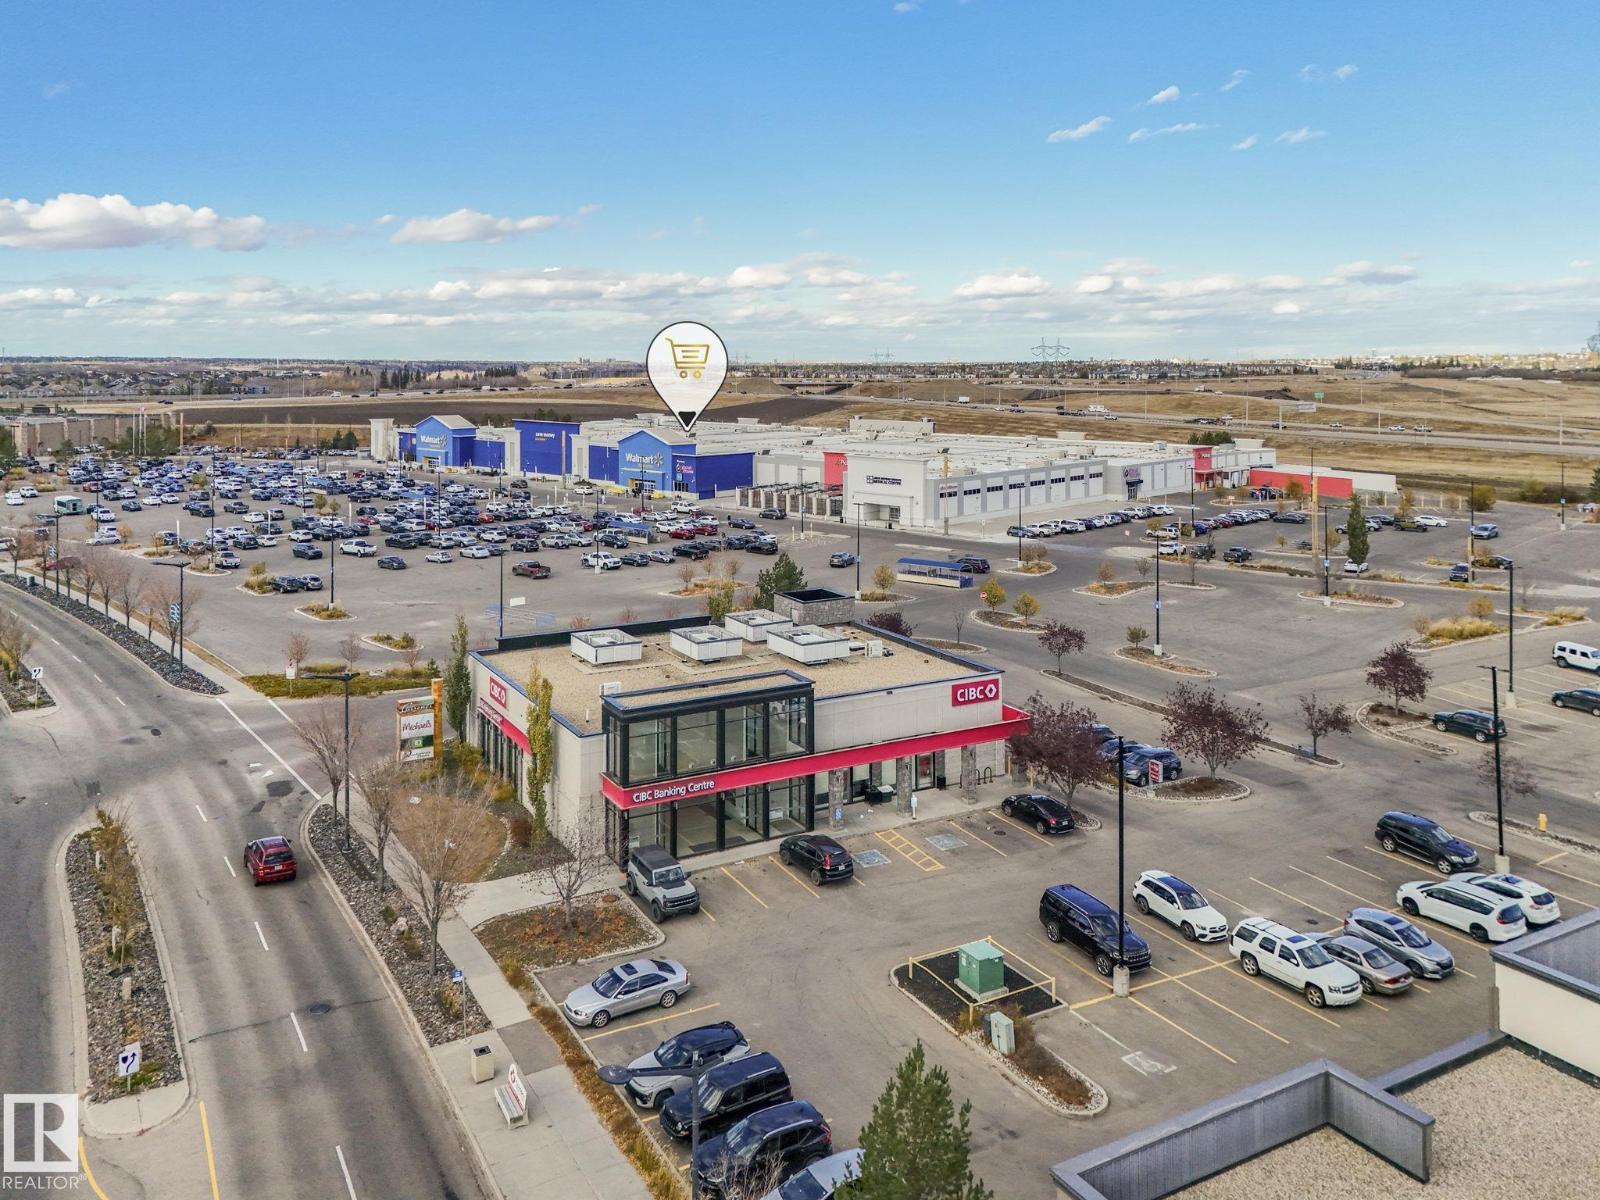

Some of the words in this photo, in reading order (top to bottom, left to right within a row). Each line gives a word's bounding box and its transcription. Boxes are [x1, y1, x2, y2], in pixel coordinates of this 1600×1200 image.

[420, 434, 441, 445] Walmart
[625, 452, 654, 464] Walmart
[956, 686, 985, 702] CIBC
[632, 790, 654, 804] CIBC
[654, 786, 688, 799] Banking
[687, 780, 716, 793] Centre
